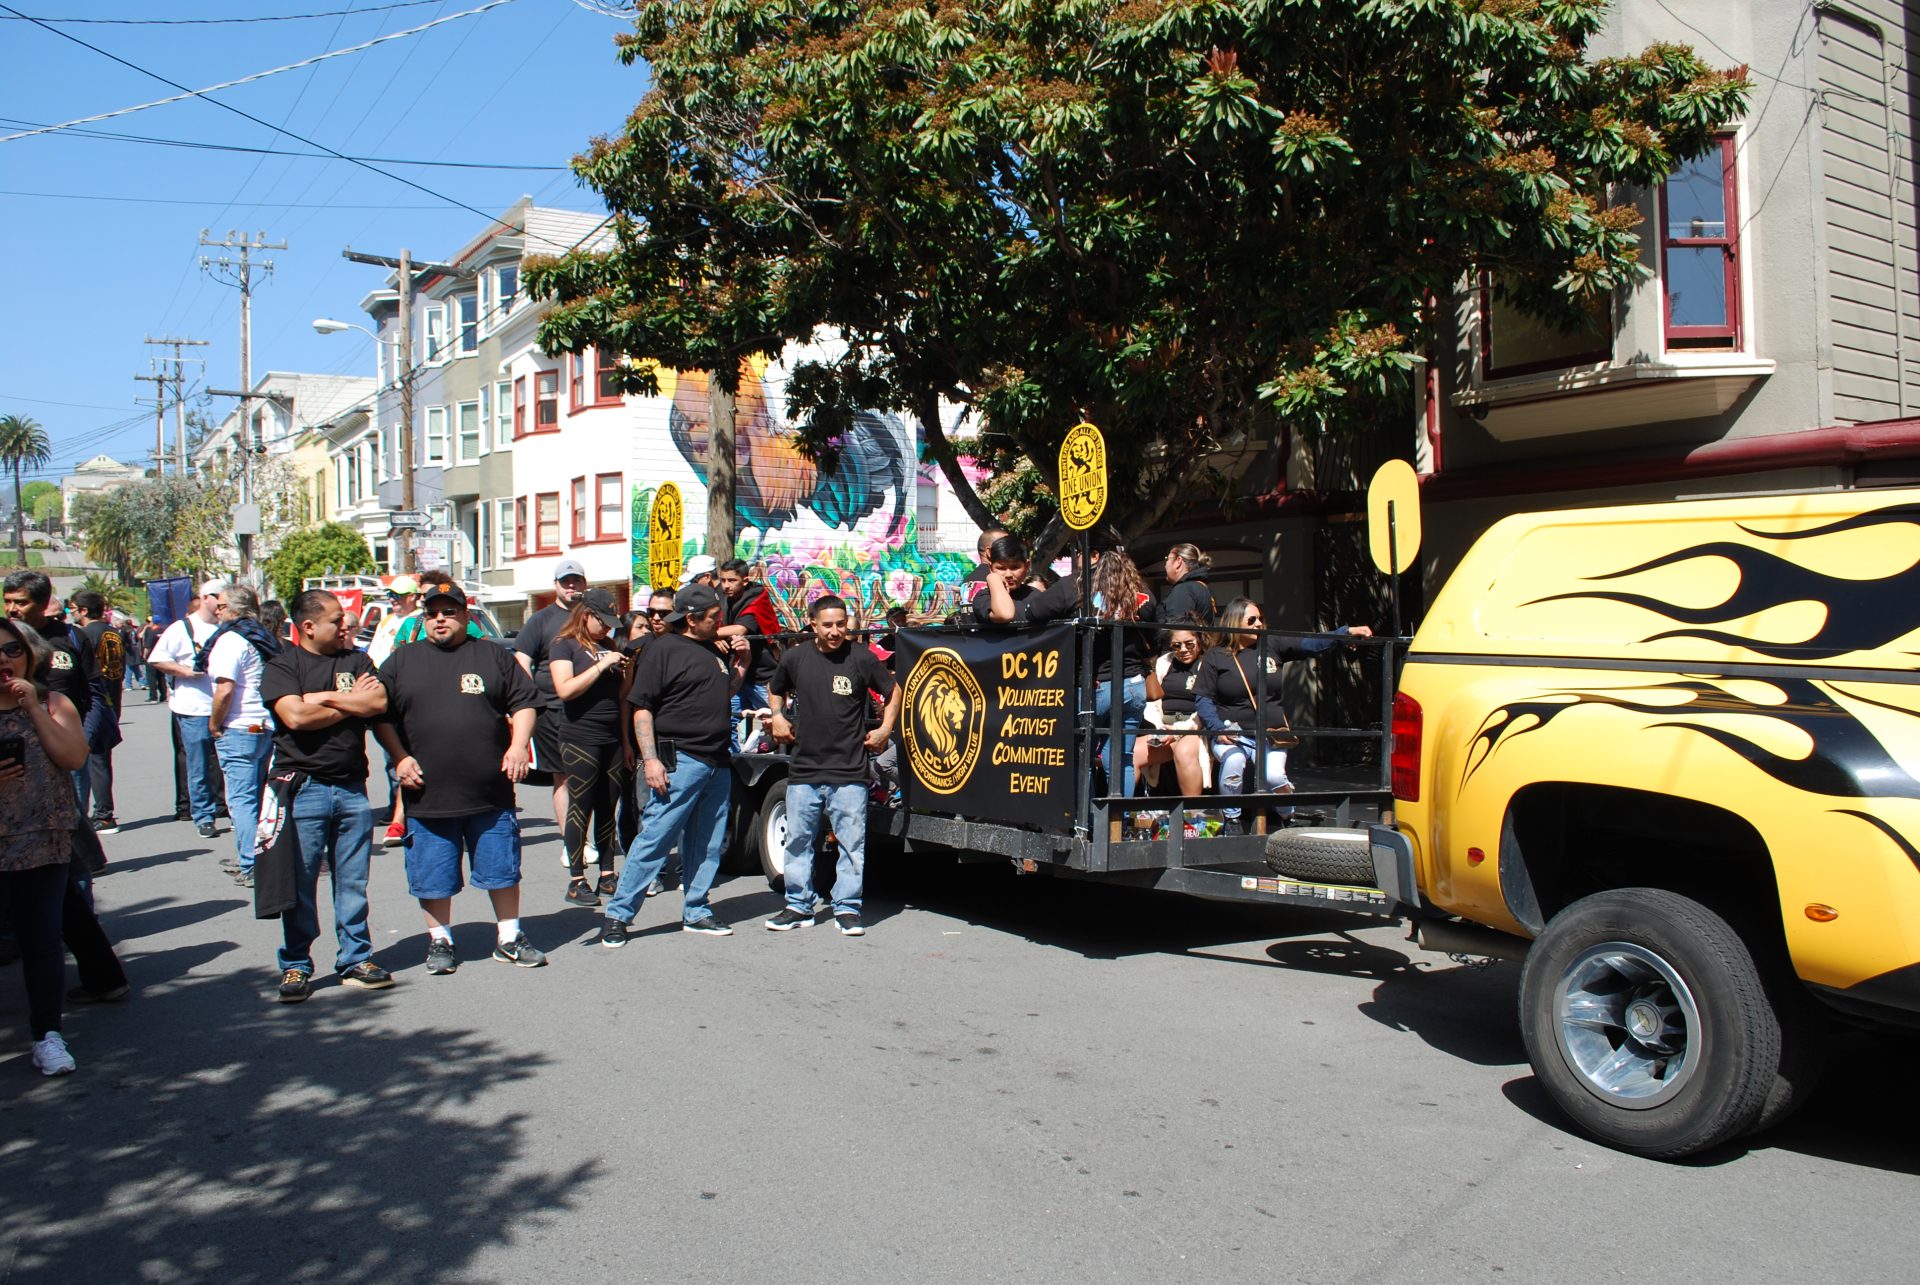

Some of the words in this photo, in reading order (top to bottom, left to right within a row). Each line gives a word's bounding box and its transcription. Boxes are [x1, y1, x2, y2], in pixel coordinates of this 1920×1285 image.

[1063, 479, 1077, 496] ONE
[1079, 470, 1102, 491] UNION
[1001, 652, 1029, 679] DC
[1032, 650, 1059, 679] 16
[905, 660, 929, 709] VOLUNTEER
[927, 653, 953, 667] ACTIVIST
[951, 660, 982, 712] COMMITTEE
[997, 685, 1064, 710] VOLUNTEER
[1000, 713, 1057, 738] ACTIVIST
[924, 748, 942, 770] DC
[943, 749, 960, 769] 16
[965, 732, 979, 765] VALUE
[992, 742, 1065, 766] COMMITTEE
[1010, 772, 1051, 794] EVENT
